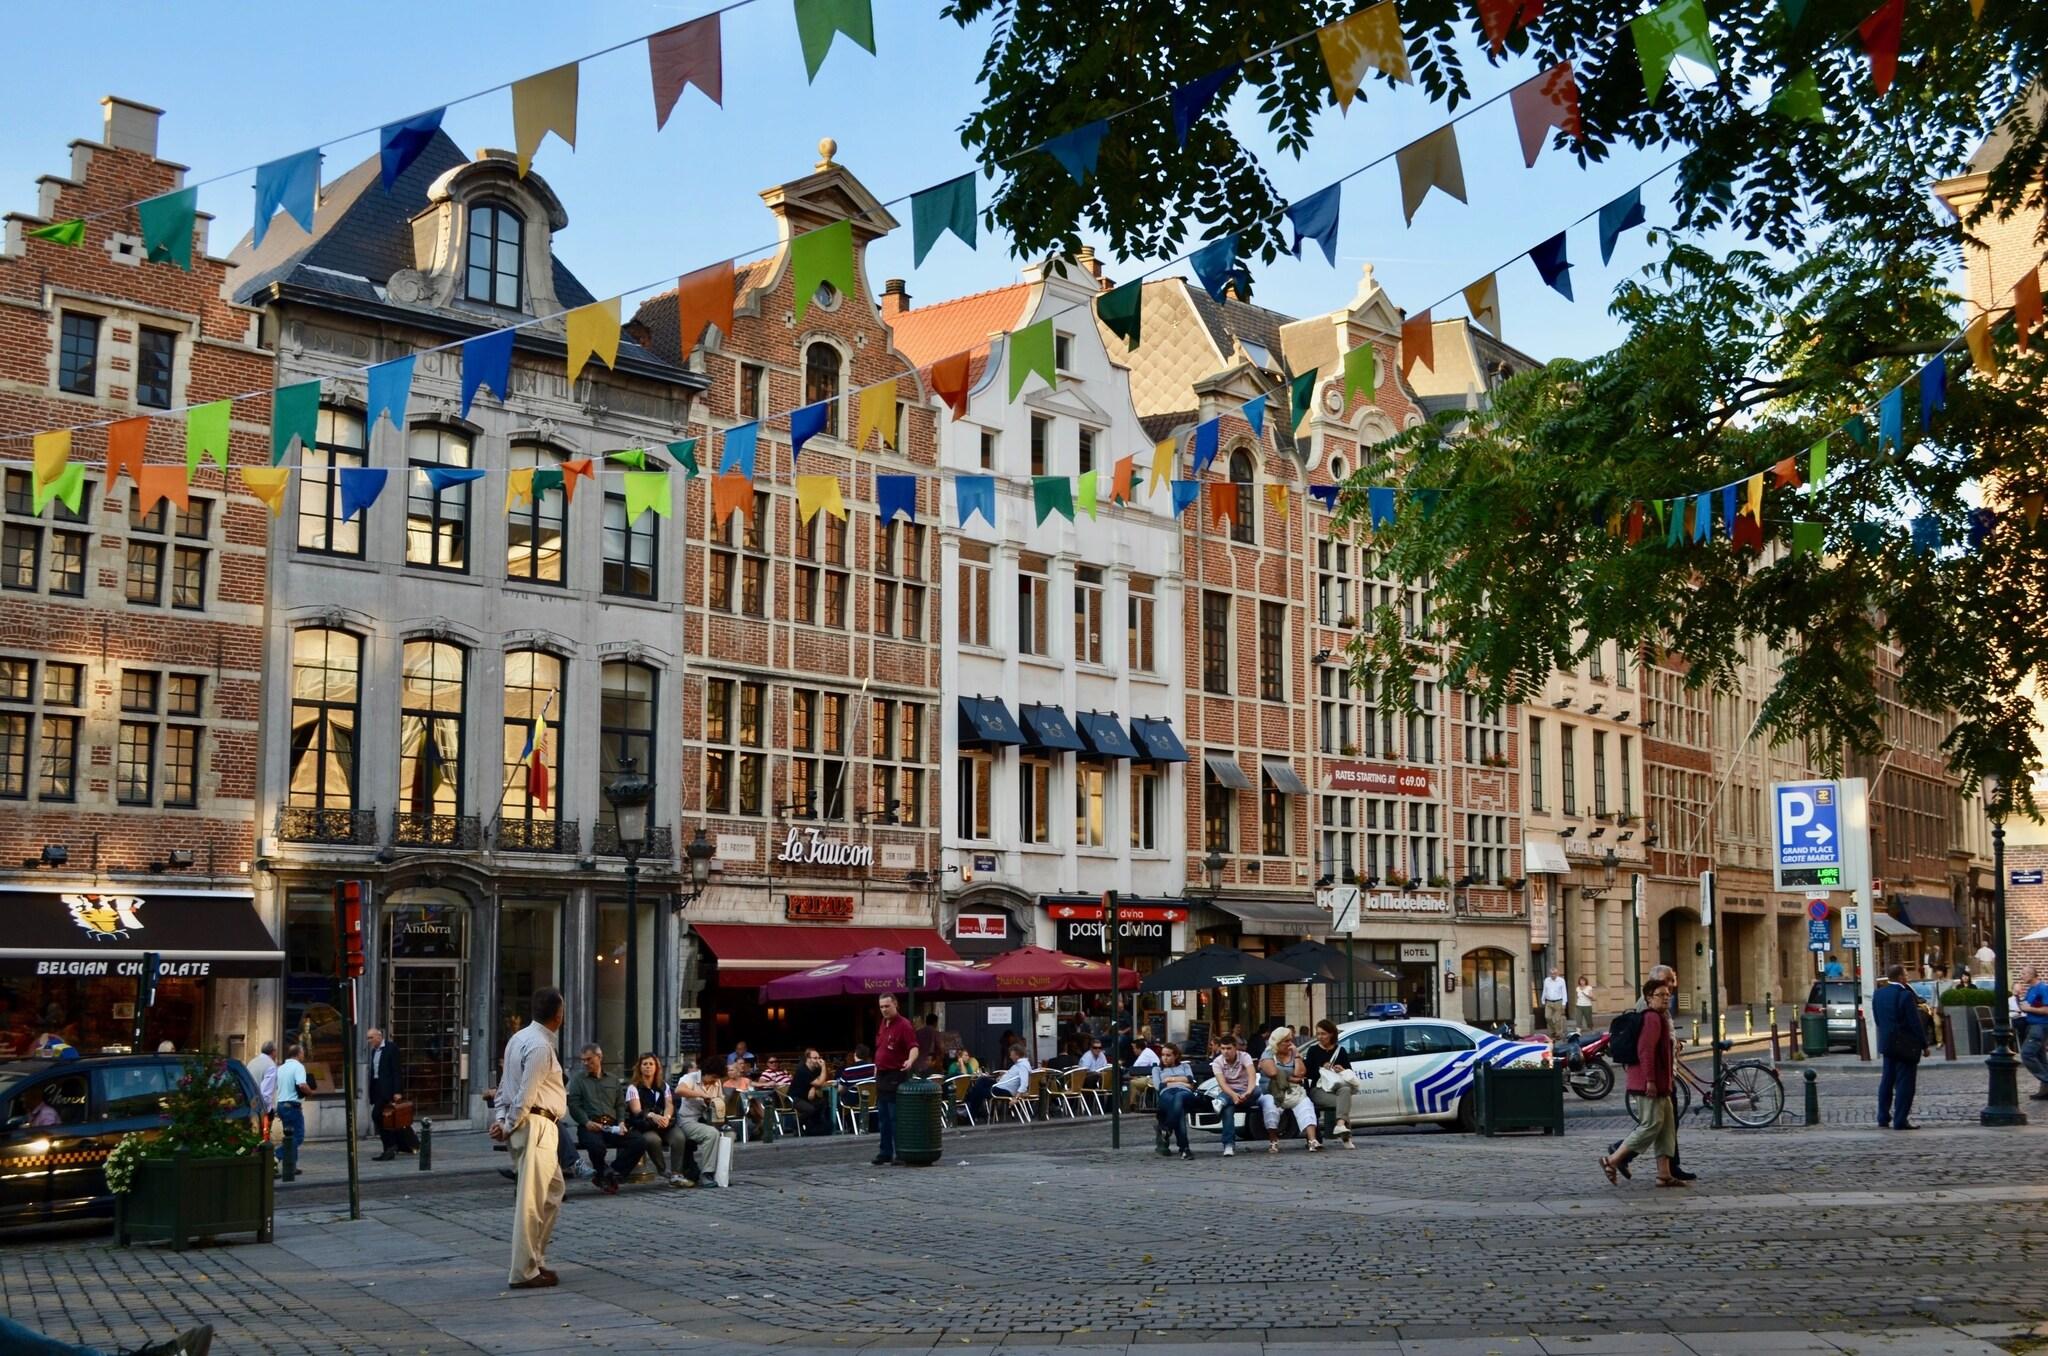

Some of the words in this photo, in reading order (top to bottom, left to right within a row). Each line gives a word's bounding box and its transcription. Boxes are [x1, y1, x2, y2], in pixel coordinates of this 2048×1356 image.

[1335, 769, 1355, 781] RATES
[1356, 772, 1386, 784] STARTING
[1388, 775, 1396, 784] AT
[1781, 792, 1814, 845] P
[778, 827, 803, 862] Le
[803, 827, 875, 866] Faucon
[1783, 847, 1808, 855] GRAND
[1810, 846, 1833, 854] PLACE
[1783, 855, 1807, 863] GROTE
[1807, 854, 1836, 862] MARKT
[1817, 869, 1839, 877] LIBRE
[788, 894, 854, 914] PRIMUS
[402, 922, 451, 934] Andorra
[1069, 922, 1103, 940] past
[1403, 949, 1429, 957] HOTEL
[37, 961, 108, 975] BELGIAN
[865, 977, 892, 989] Keizer
